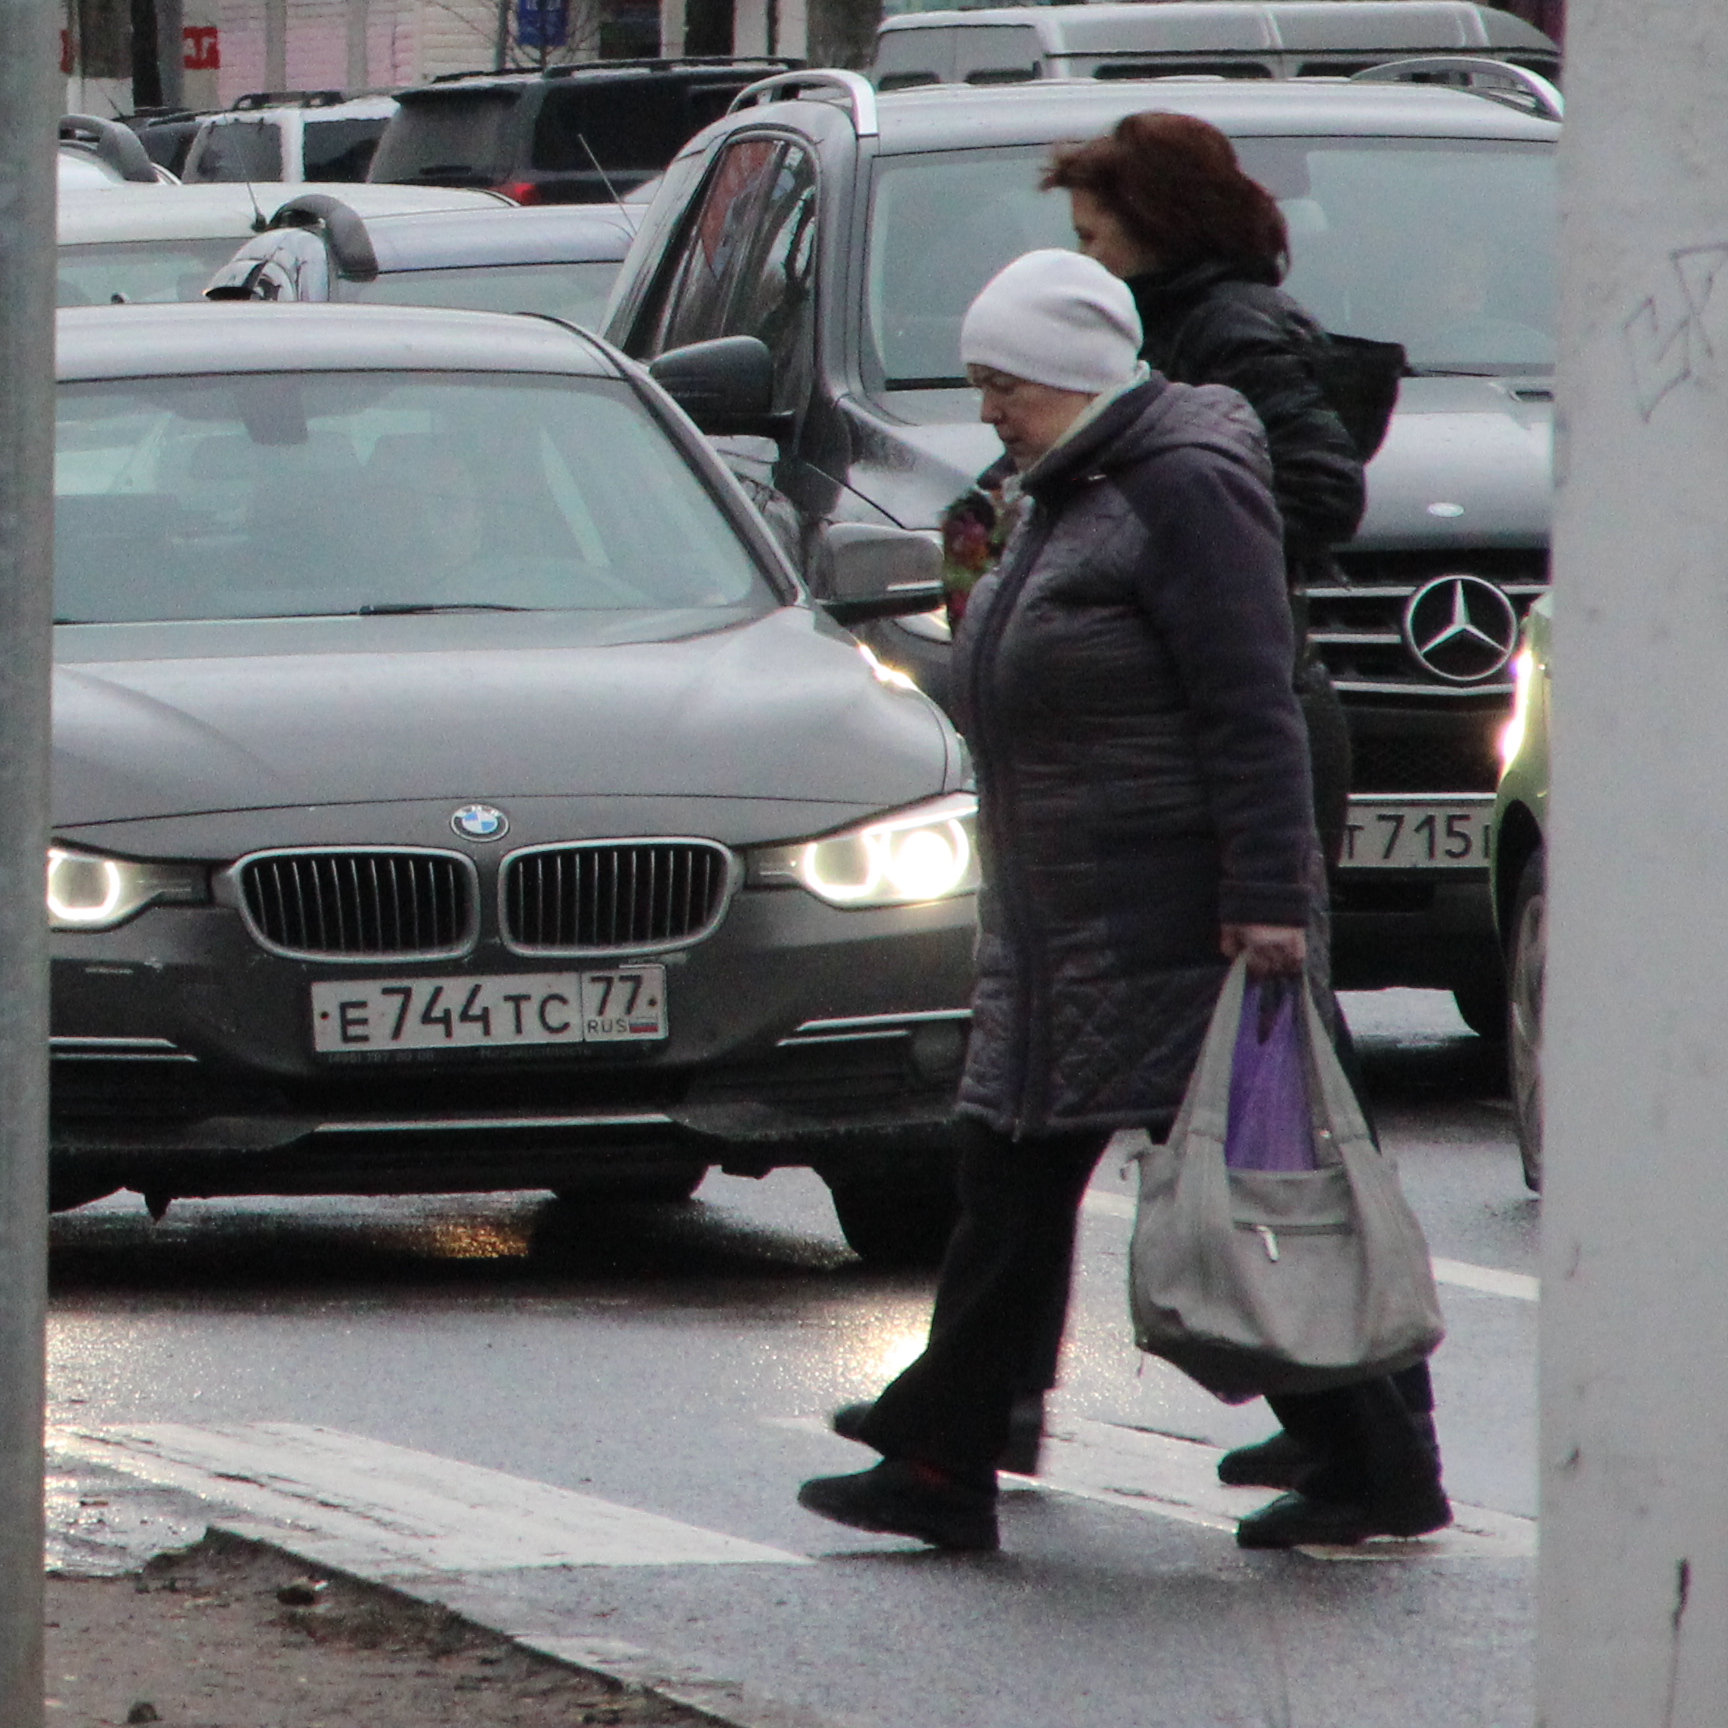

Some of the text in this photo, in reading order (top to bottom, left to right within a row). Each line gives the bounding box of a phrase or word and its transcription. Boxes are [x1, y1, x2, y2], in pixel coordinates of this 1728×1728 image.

[338, 974, 643, 1045] Е744ТС 77
[586, 1018, 627, 1035] RUS
